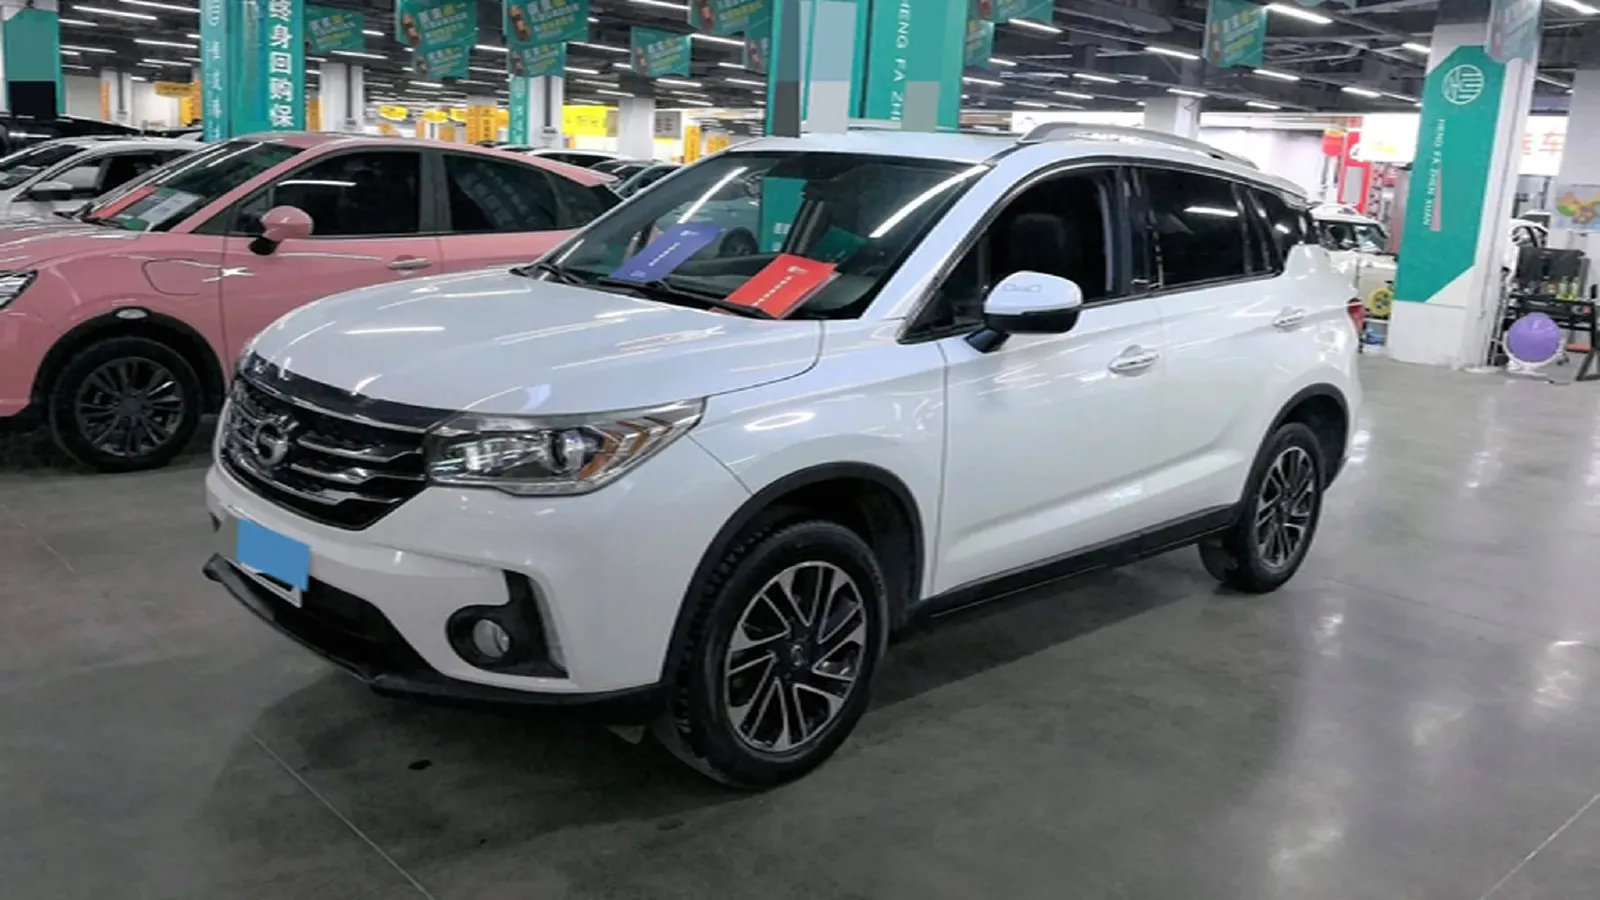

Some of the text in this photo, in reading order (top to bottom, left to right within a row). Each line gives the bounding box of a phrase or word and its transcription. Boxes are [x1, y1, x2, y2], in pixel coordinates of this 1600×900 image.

[893, 58, 906, 81] FA
[1434, 118, 1446, 147] HENG
[1431, 151, 1442, 164] FA
[1423, 199, 1434, 226] XUAN
